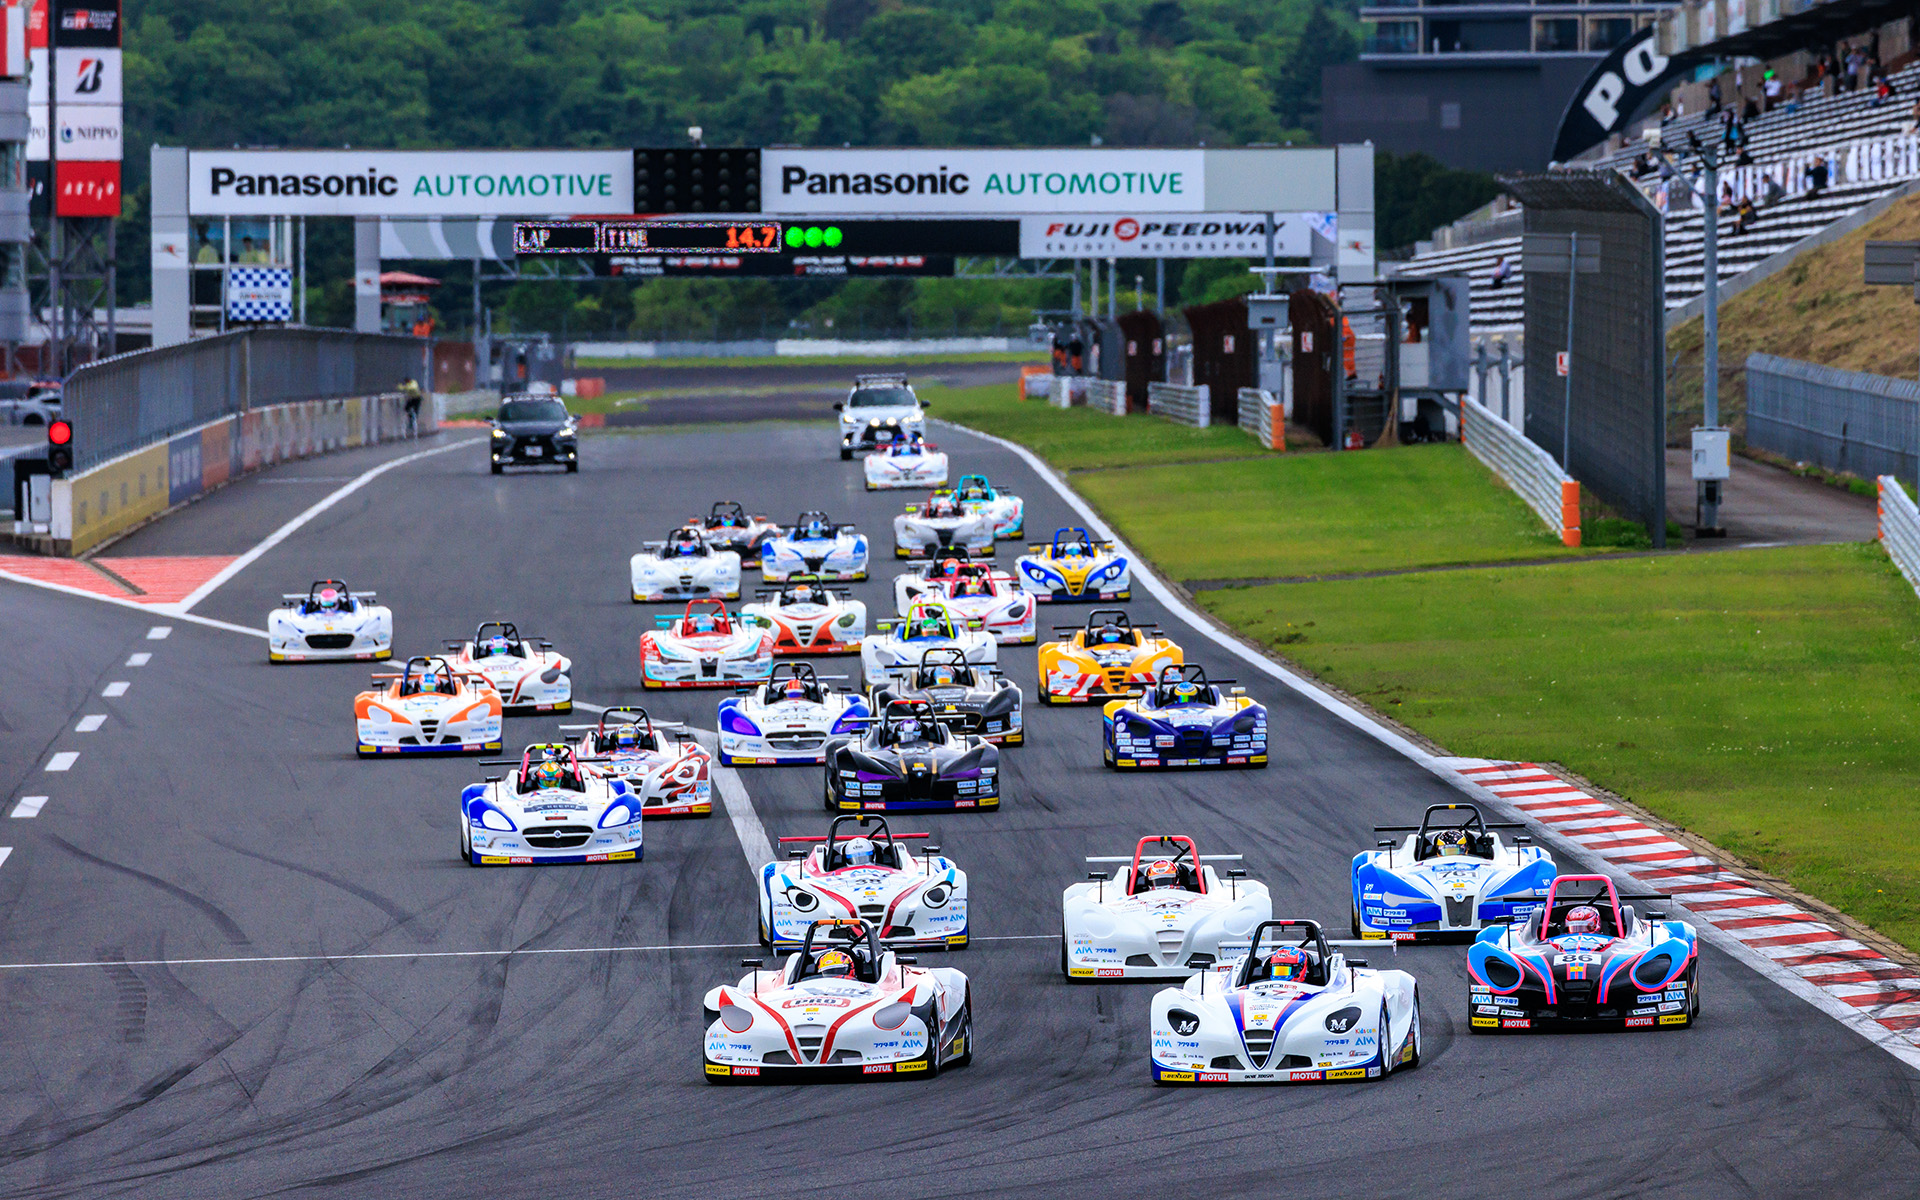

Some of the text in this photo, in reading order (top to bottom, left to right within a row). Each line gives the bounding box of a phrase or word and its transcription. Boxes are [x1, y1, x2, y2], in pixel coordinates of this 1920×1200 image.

[77, 128, 118, 139] NIPPO
[211, 168, 612, 196] Panasonic AUTOMOTIVE
[782, 166, 1183, 194] Panasonic AUTOMOTIVE
[1046, 223, 1110, 237] FUJI
[518, 230, 550, 247] LAP
[608, 227, 775, 247] TIME 14.7
[1367, 907, 1381, 915] AIM
[1562, 954, 1593, 962] 86
[1473, 995, 1491, 1004] AIM
[1666, 991, 1685, 1000] AIM
[1627, 1018, 1653, 1026] MOTUL
[902, 1039, 923, 1048] AIM
[1155, 1039, 1172, 1048] AIM
[1355, 1036, 1376, 1046] AIM
[709, 1042, 727, 1050] AIM
[733, 1067, 759, 1075] MOTUL
[864, 1064, 892, 1073] MOTUL
[1200, 1073, 1228, 1081] MOTUL
[1291, 1072, 1320, 1080] MOTUL
